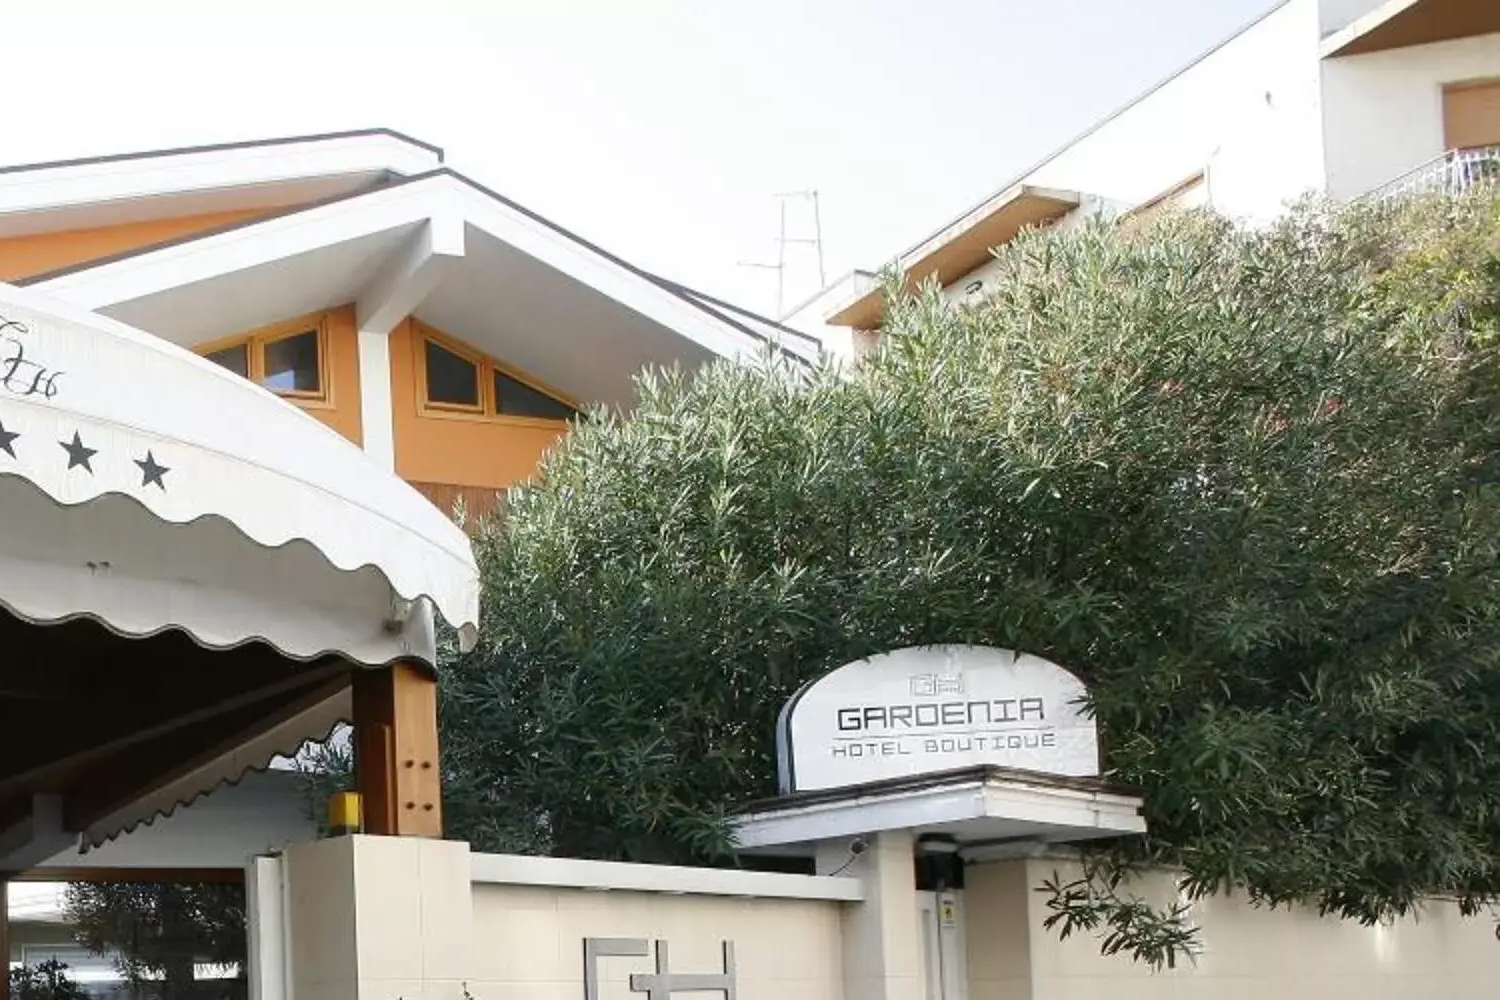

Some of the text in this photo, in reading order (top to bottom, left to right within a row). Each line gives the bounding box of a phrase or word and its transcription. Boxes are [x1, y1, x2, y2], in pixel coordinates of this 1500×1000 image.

[837, 698, 1044, 731] GARDENIA
[831, 733, 1056, 757] HOTEL BOUTIQUE
